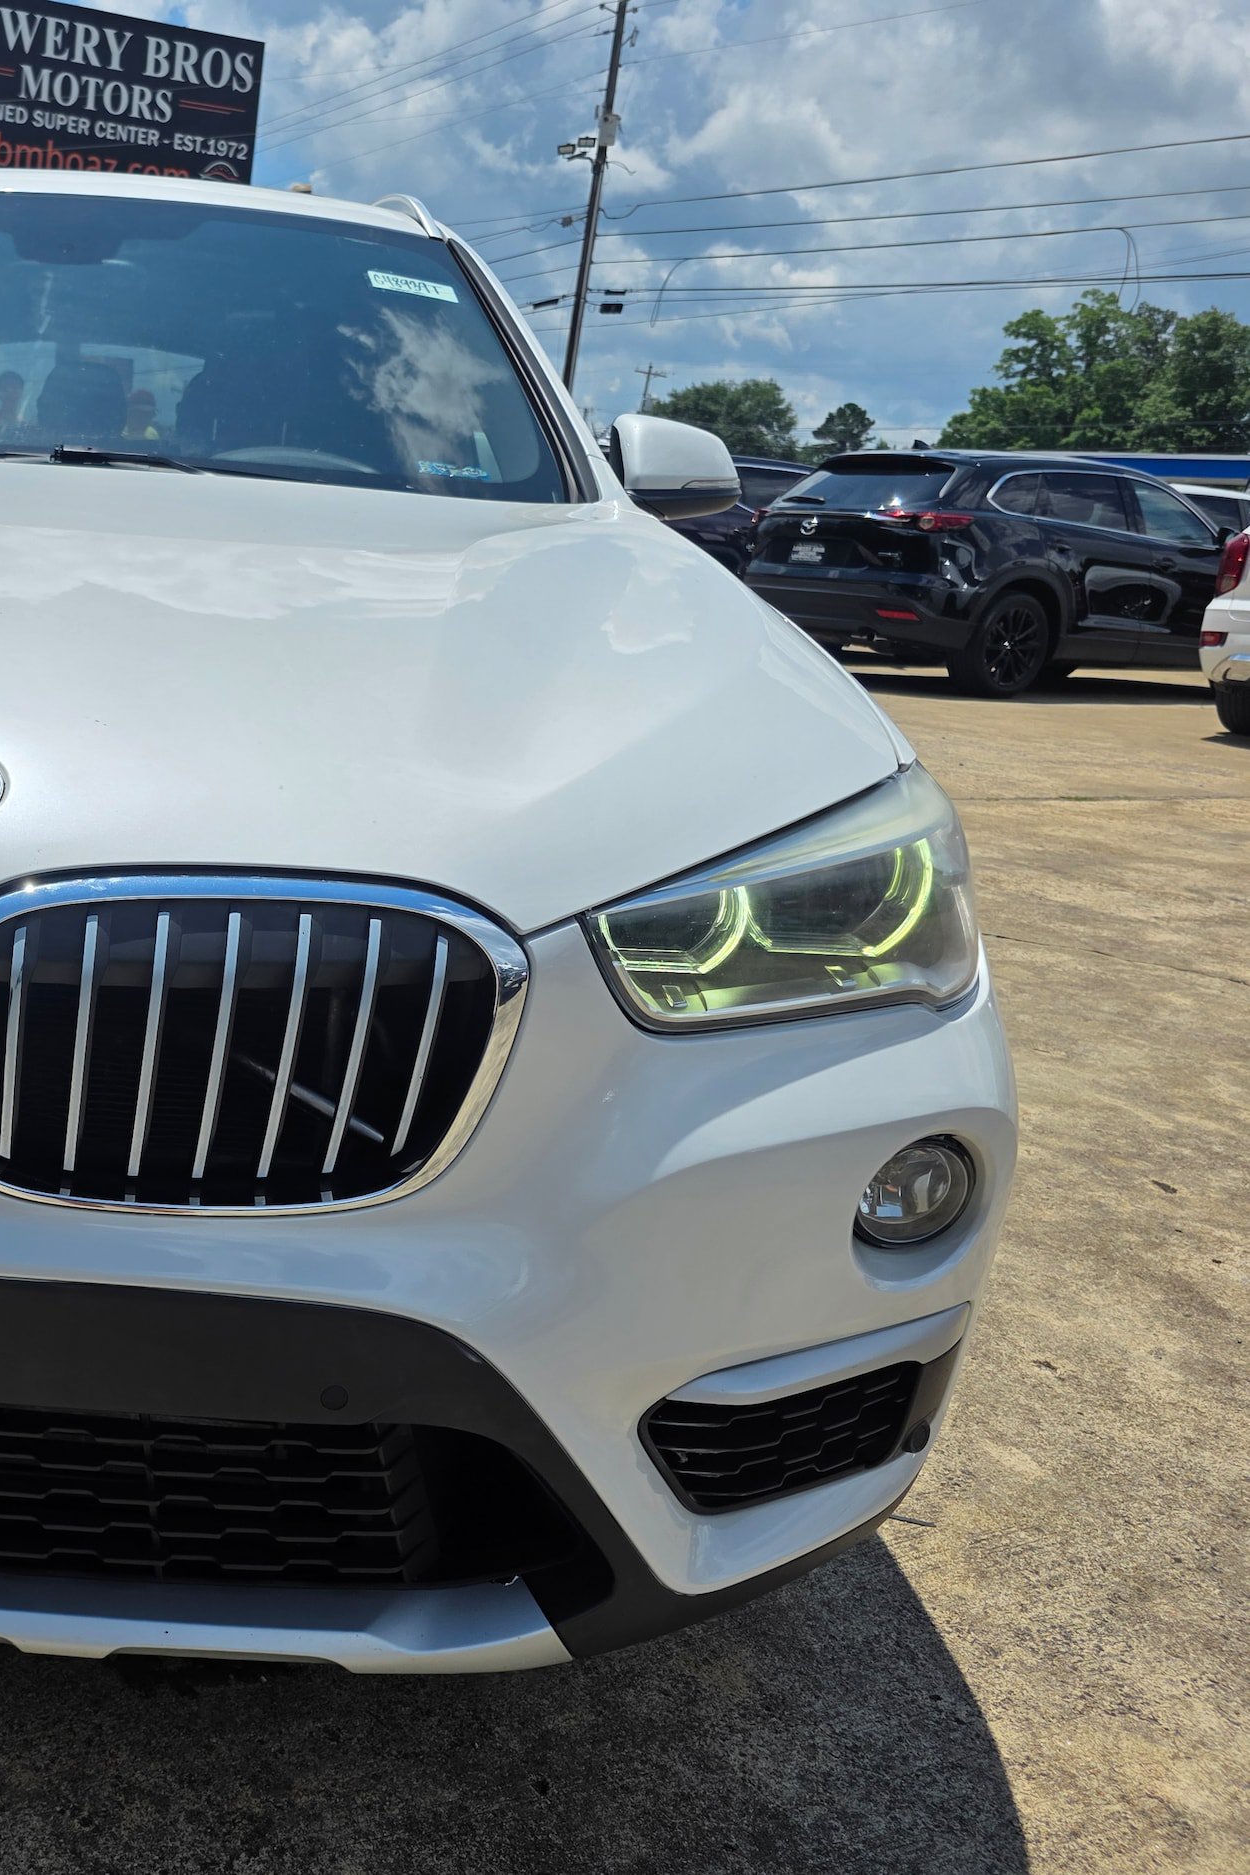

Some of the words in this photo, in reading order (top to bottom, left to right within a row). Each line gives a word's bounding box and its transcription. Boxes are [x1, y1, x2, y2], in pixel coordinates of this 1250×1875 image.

[17, 64, 173, 124] MOTORS
[143, 35, 254, 94] BROS
[32, 109, 91, 137] SUPER
[94, 120, 161, 148] CENTER
[173, 133, 248, 161] EST.1972
